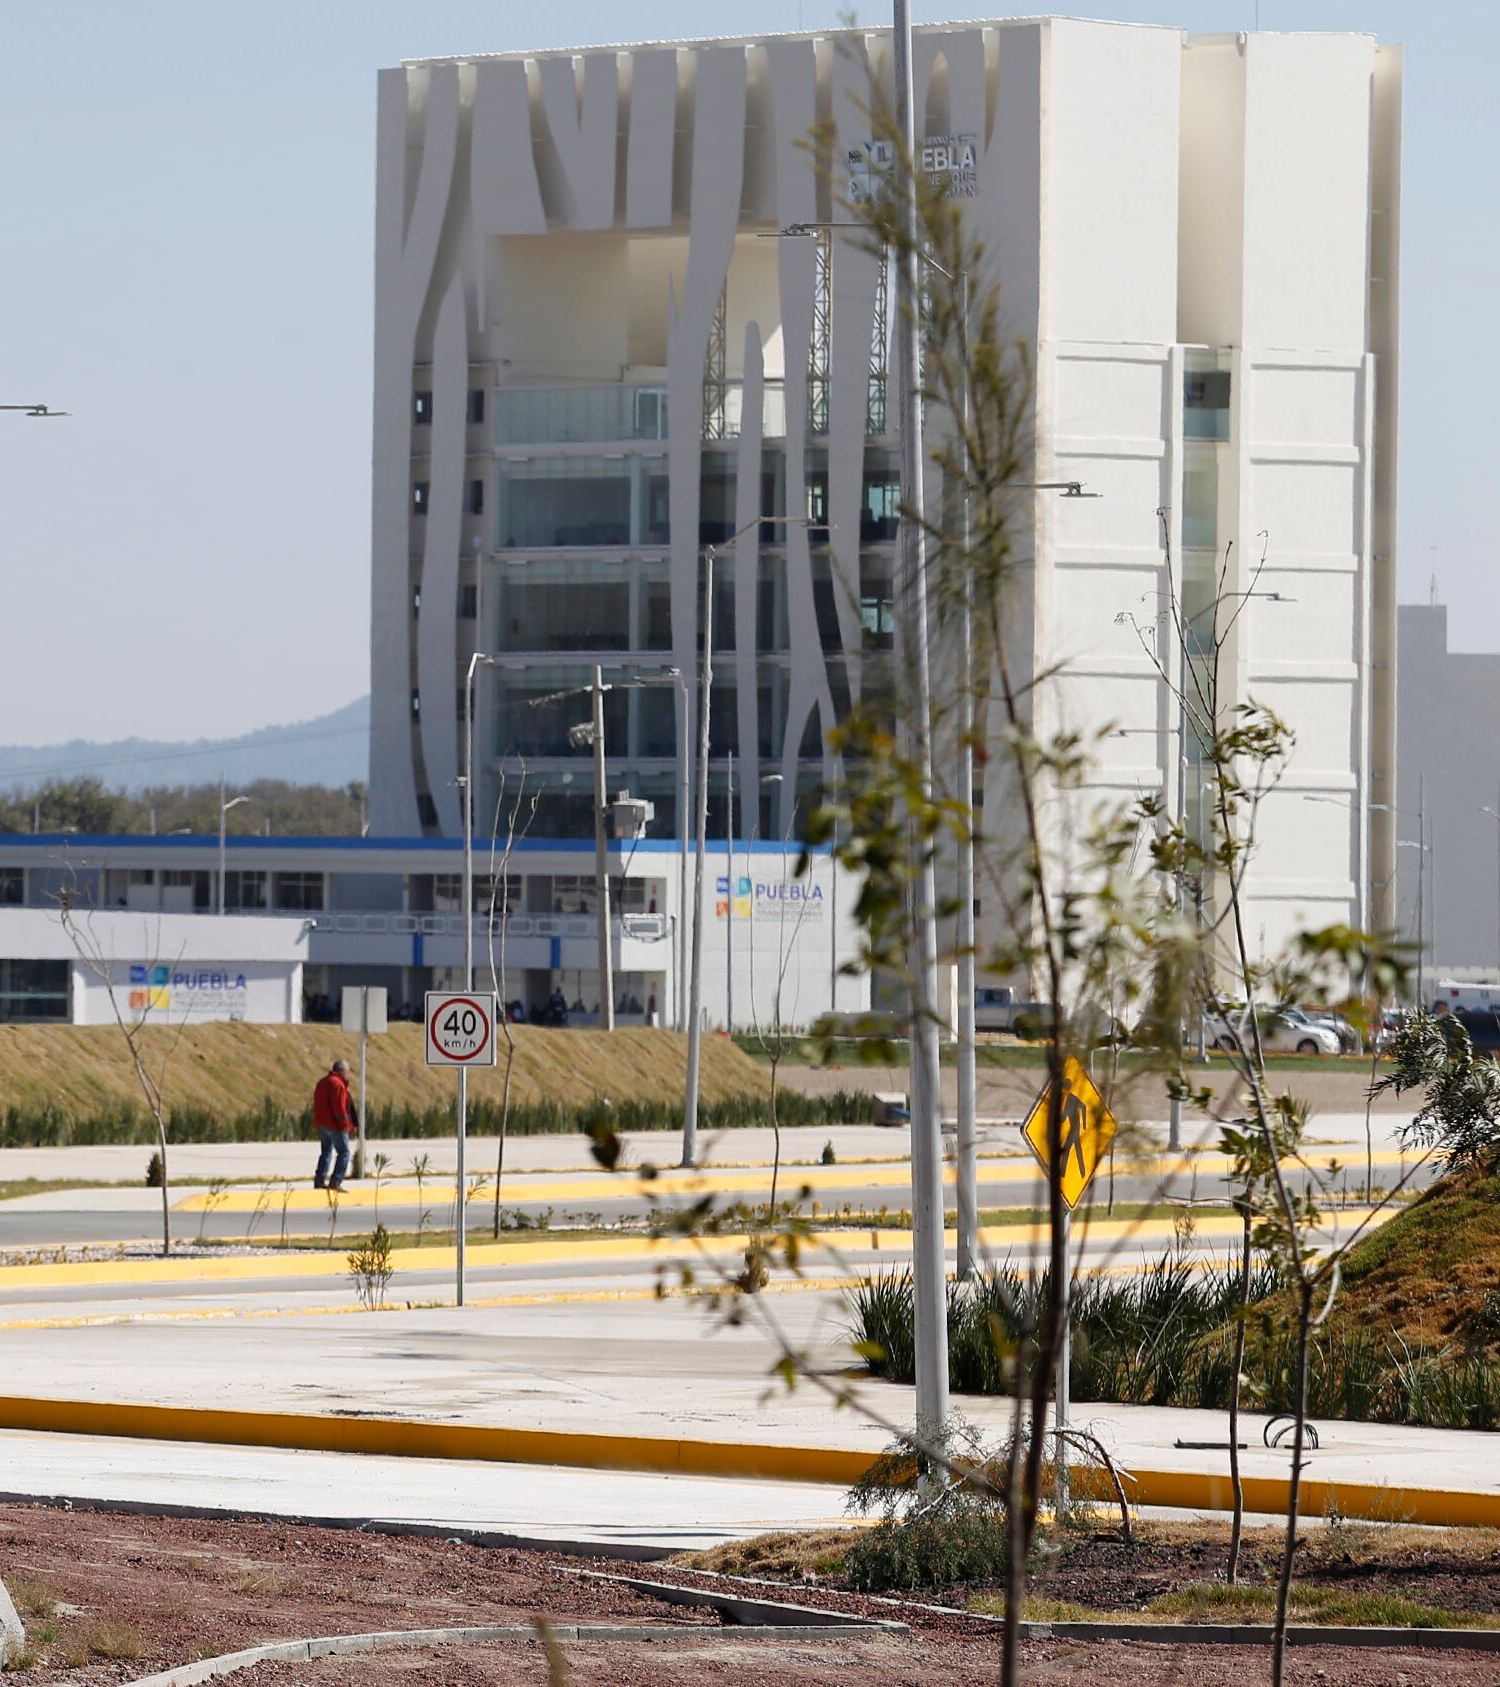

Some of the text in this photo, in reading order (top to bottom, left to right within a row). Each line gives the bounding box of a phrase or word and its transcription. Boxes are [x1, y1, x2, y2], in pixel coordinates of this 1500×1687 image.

[921, 143, 976, 172] EBLA
[755, 884, 824, 901] PUEBLA
[172, 972, 247, 990] PUEBLA
[443, 1010, 477, 1036] 40
[444, 1038, 476, 1049] km/h
